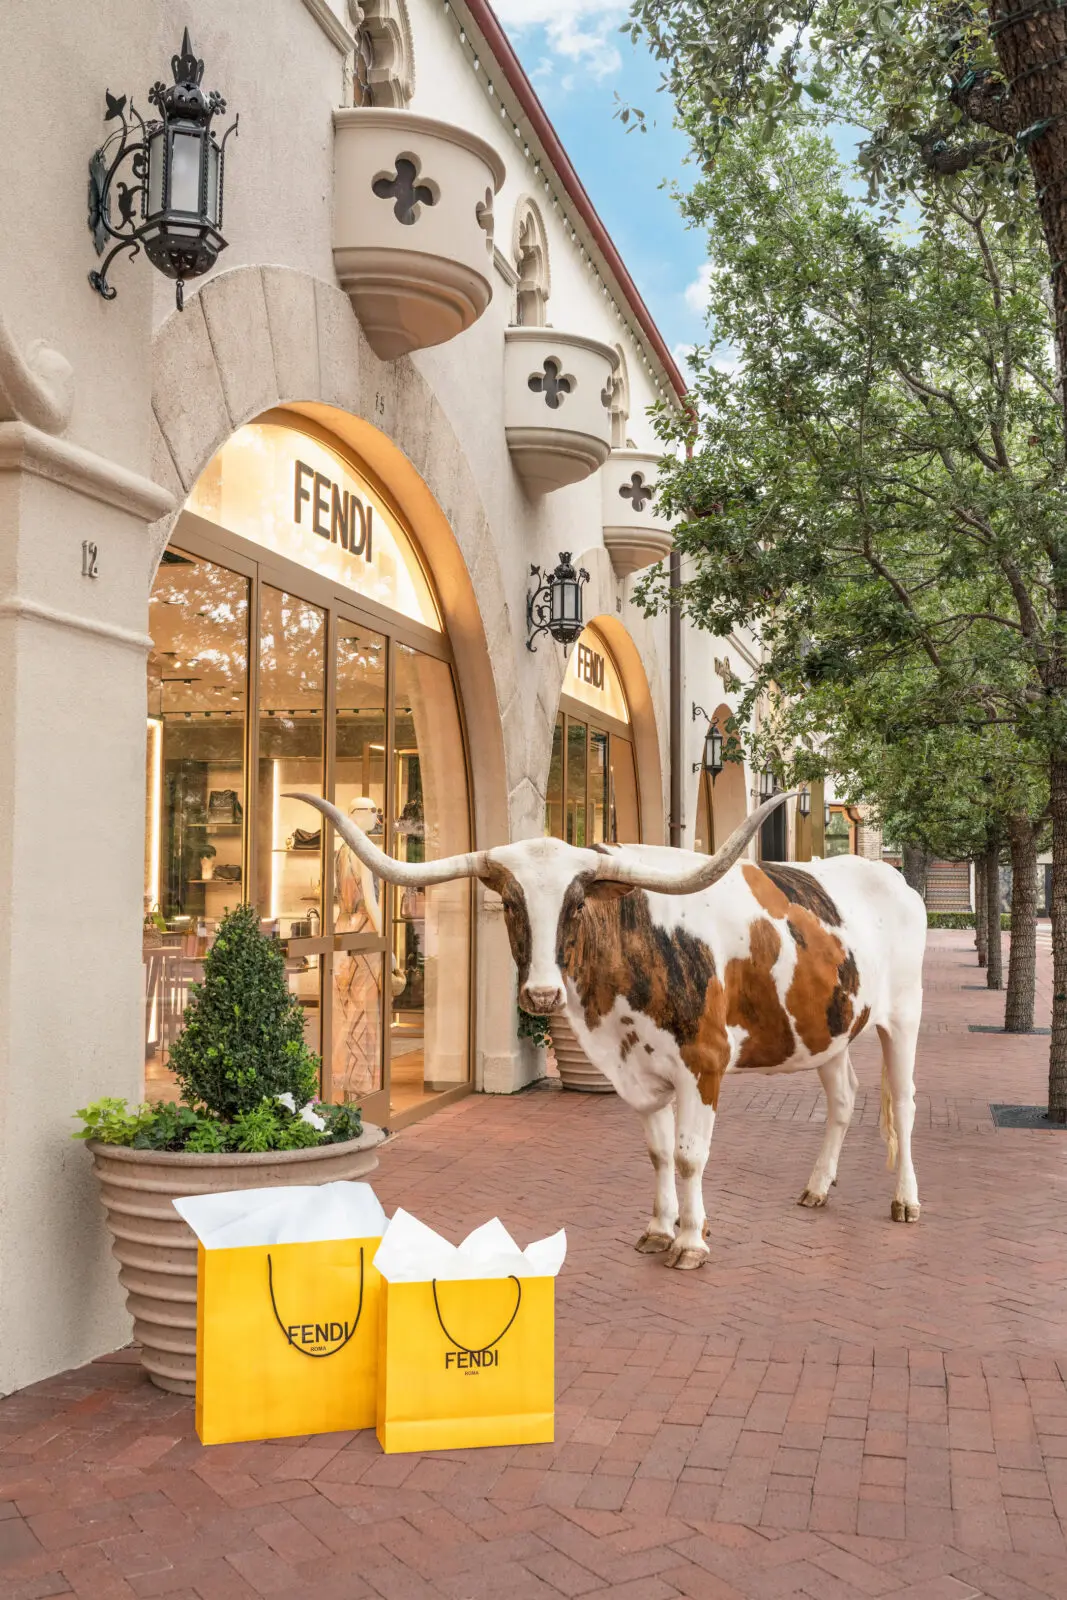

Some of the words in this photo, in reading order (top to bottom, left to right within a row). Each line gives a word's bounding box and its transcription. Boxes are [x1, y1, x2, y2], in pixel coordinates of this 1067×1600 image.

[294, 459, 373, 563] FENDI
[81, 540, 99, 579] 12
[577, 642, 605, 692] FENDI
[288, 1321, 349, 1345] FENDI
[445, 1349, 499, 1370] FENDI
